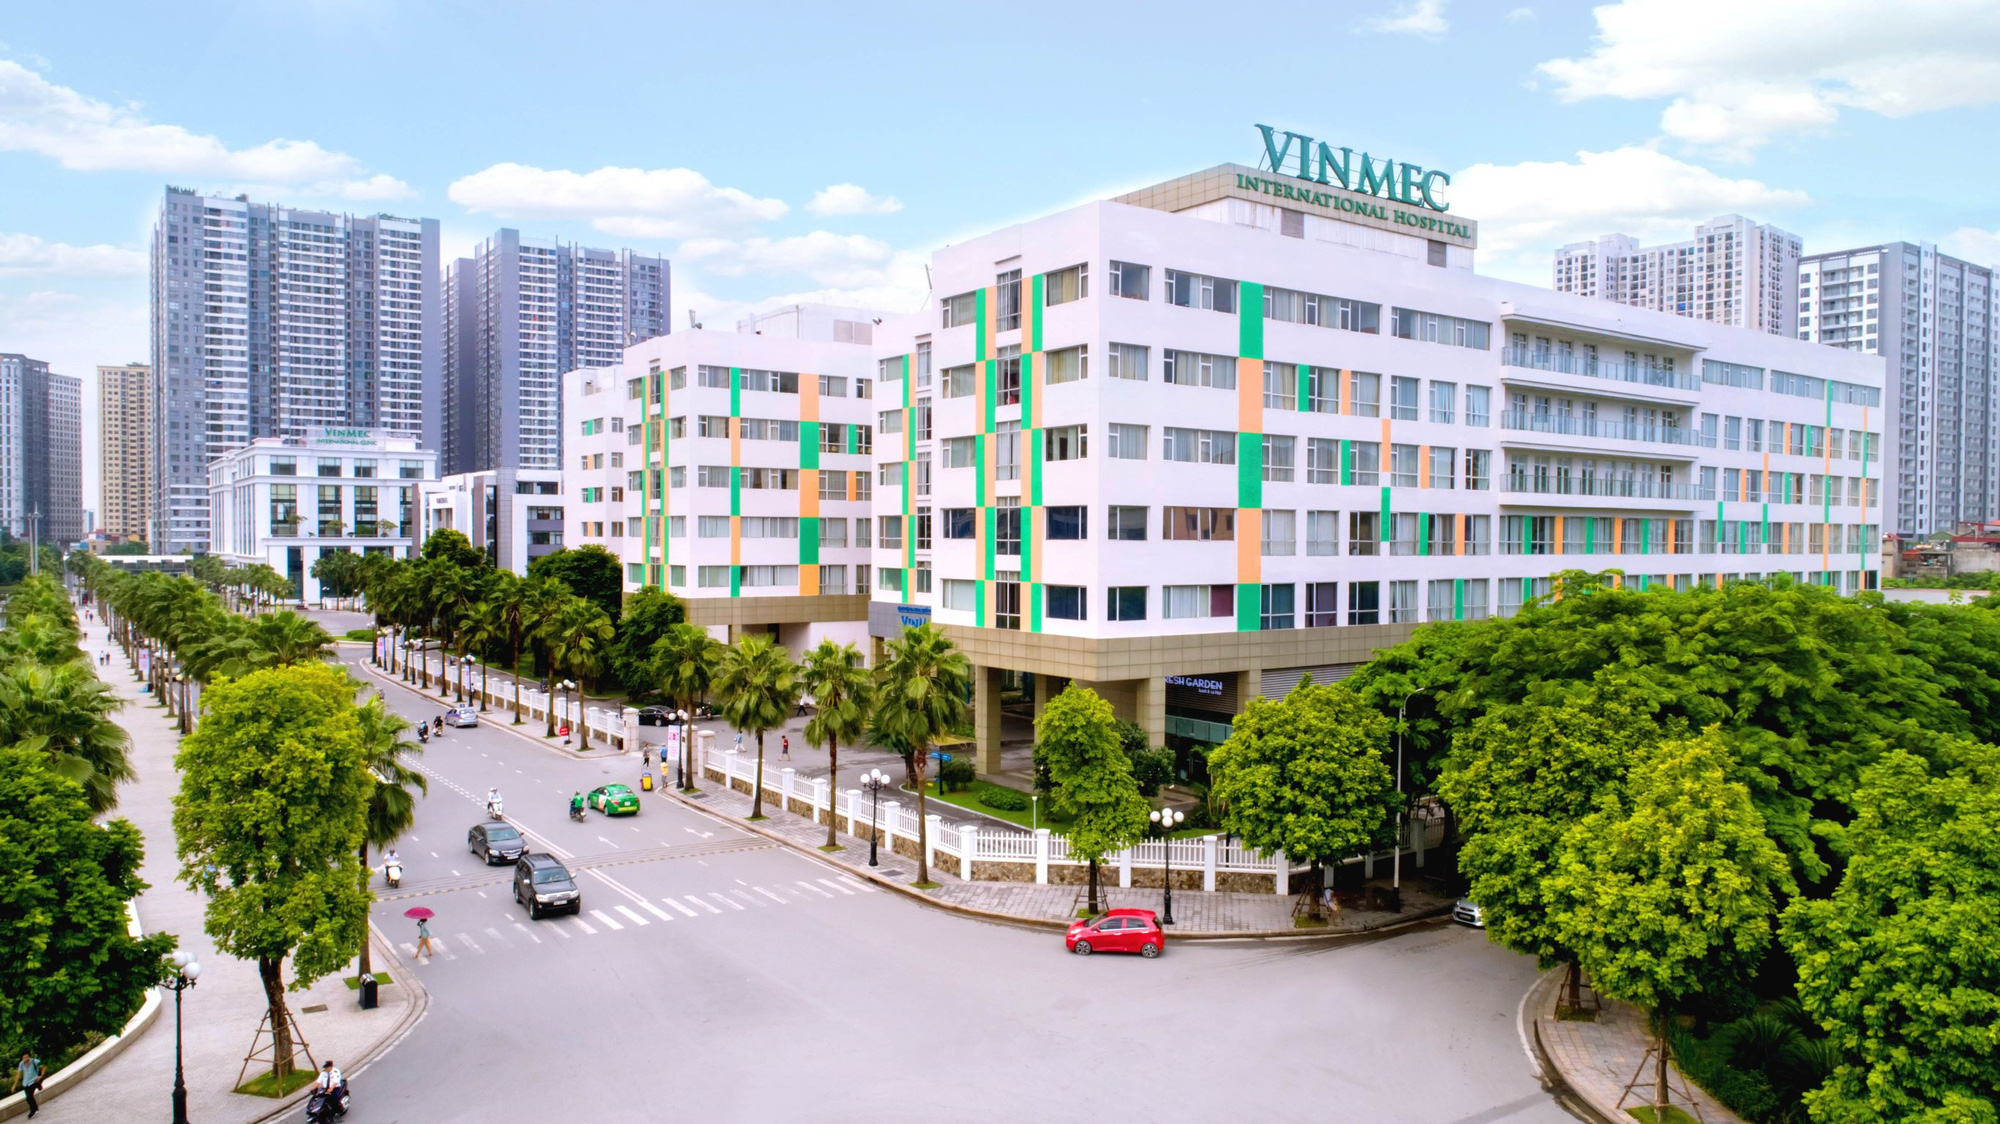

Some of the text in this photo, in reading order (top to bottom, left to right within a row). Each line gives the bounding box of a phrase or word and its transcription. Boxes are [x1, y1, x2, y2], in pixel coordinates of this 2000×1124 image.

[1254, 123, 1450, 212] VINMEC
[1236, 173, 1471, 239] INTERNATIONAL HOSPITAL
[1165, 676, 1223, 690] RESH GARDEN
